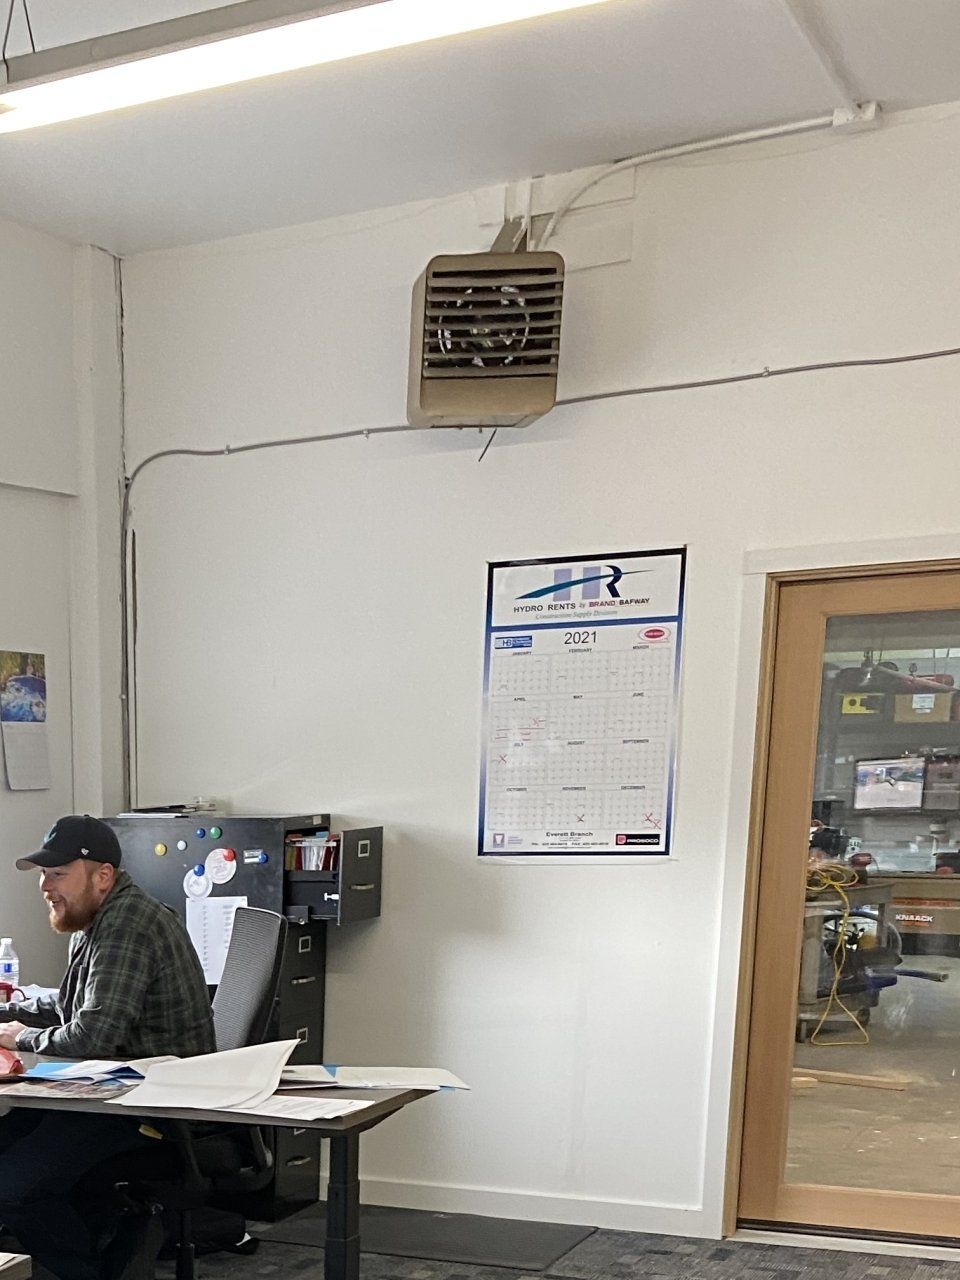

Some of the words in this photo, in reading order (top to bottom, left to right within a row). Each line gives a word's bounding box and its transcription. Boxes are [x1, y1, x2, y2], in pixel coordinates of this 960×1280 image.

[513, 604, 544, 613] HYDRO
[547, 602, 576, 611] RENTS
[588, 600, 616, 608] BRAND
[564, 631, 597, 645] 2021
[895, 914, 934, 922] KNAACK
